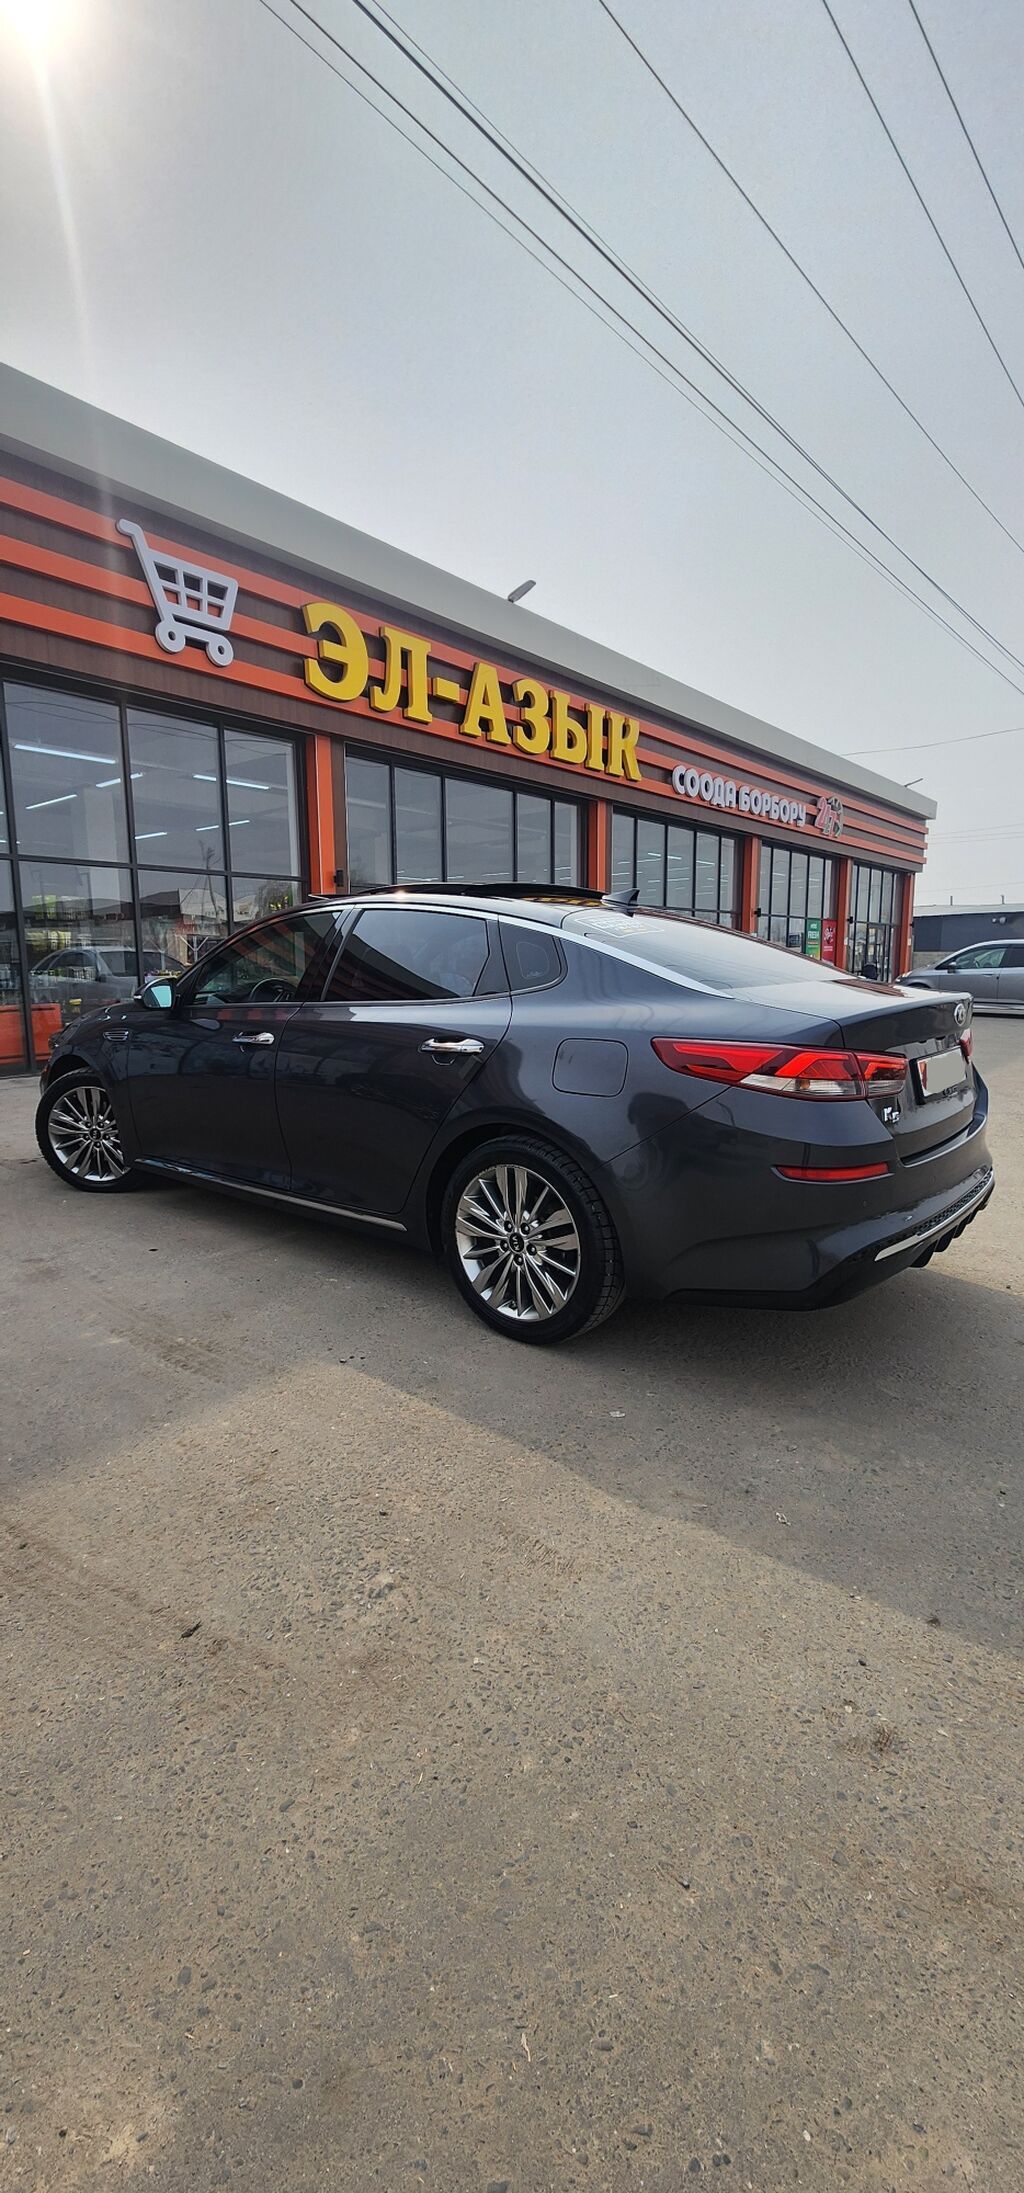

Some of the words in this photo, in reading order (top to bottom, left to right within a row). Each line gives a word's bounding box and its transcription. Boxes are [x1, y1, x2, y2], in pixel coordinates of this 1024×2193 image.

[303, 602, 642, 781] ЭЛ-АЗЫК
[672, 765, 737, 808] СООДА
[738, 785, 806, 827] БОРБОРУ
[883, 1107, 900, 1123] K5
